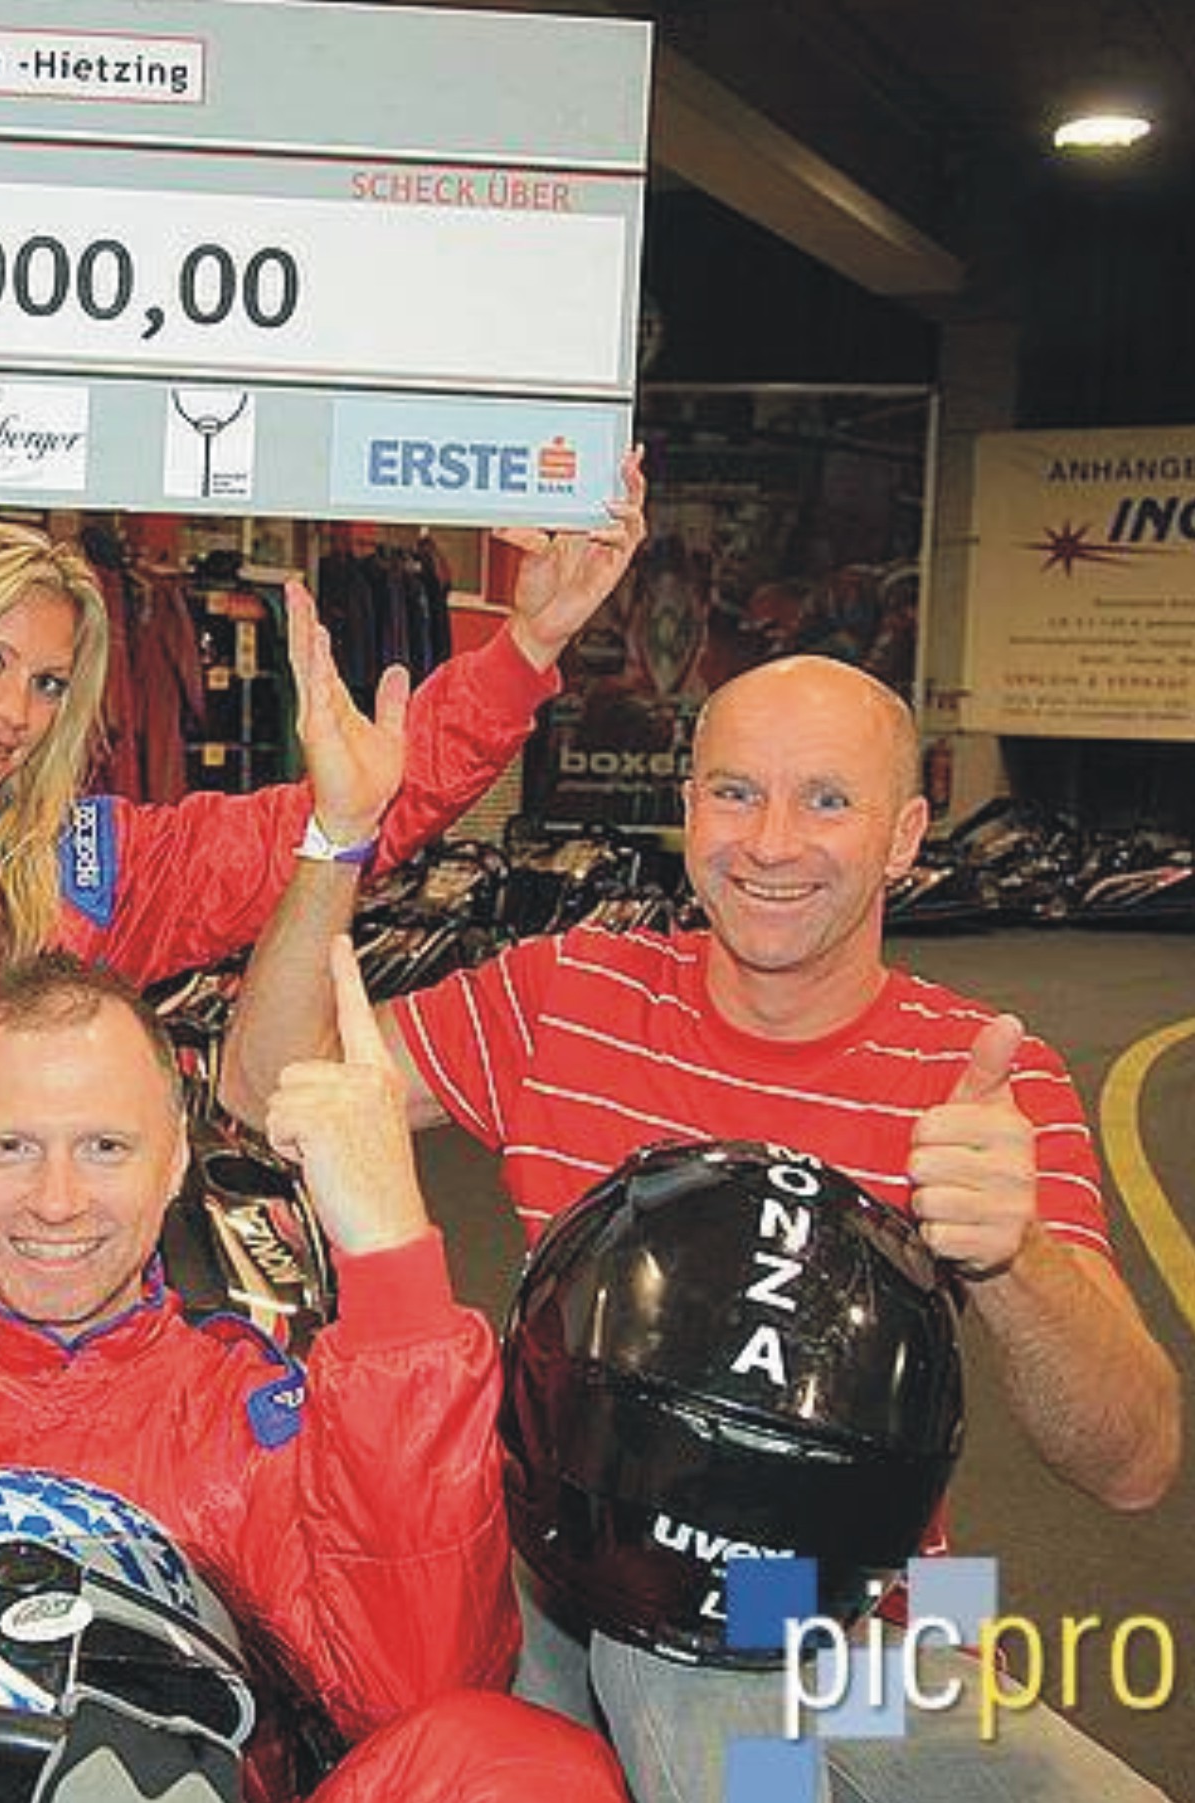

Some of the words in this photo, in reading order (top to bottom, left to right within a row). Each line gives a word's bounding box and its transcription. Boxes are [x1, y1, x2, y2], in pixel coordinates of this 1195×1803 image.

[351, 171, 474, 207] SCHECK
[488, 171, 571, 213] ÜBER
[368, 439, 528, 493] ERSTE
